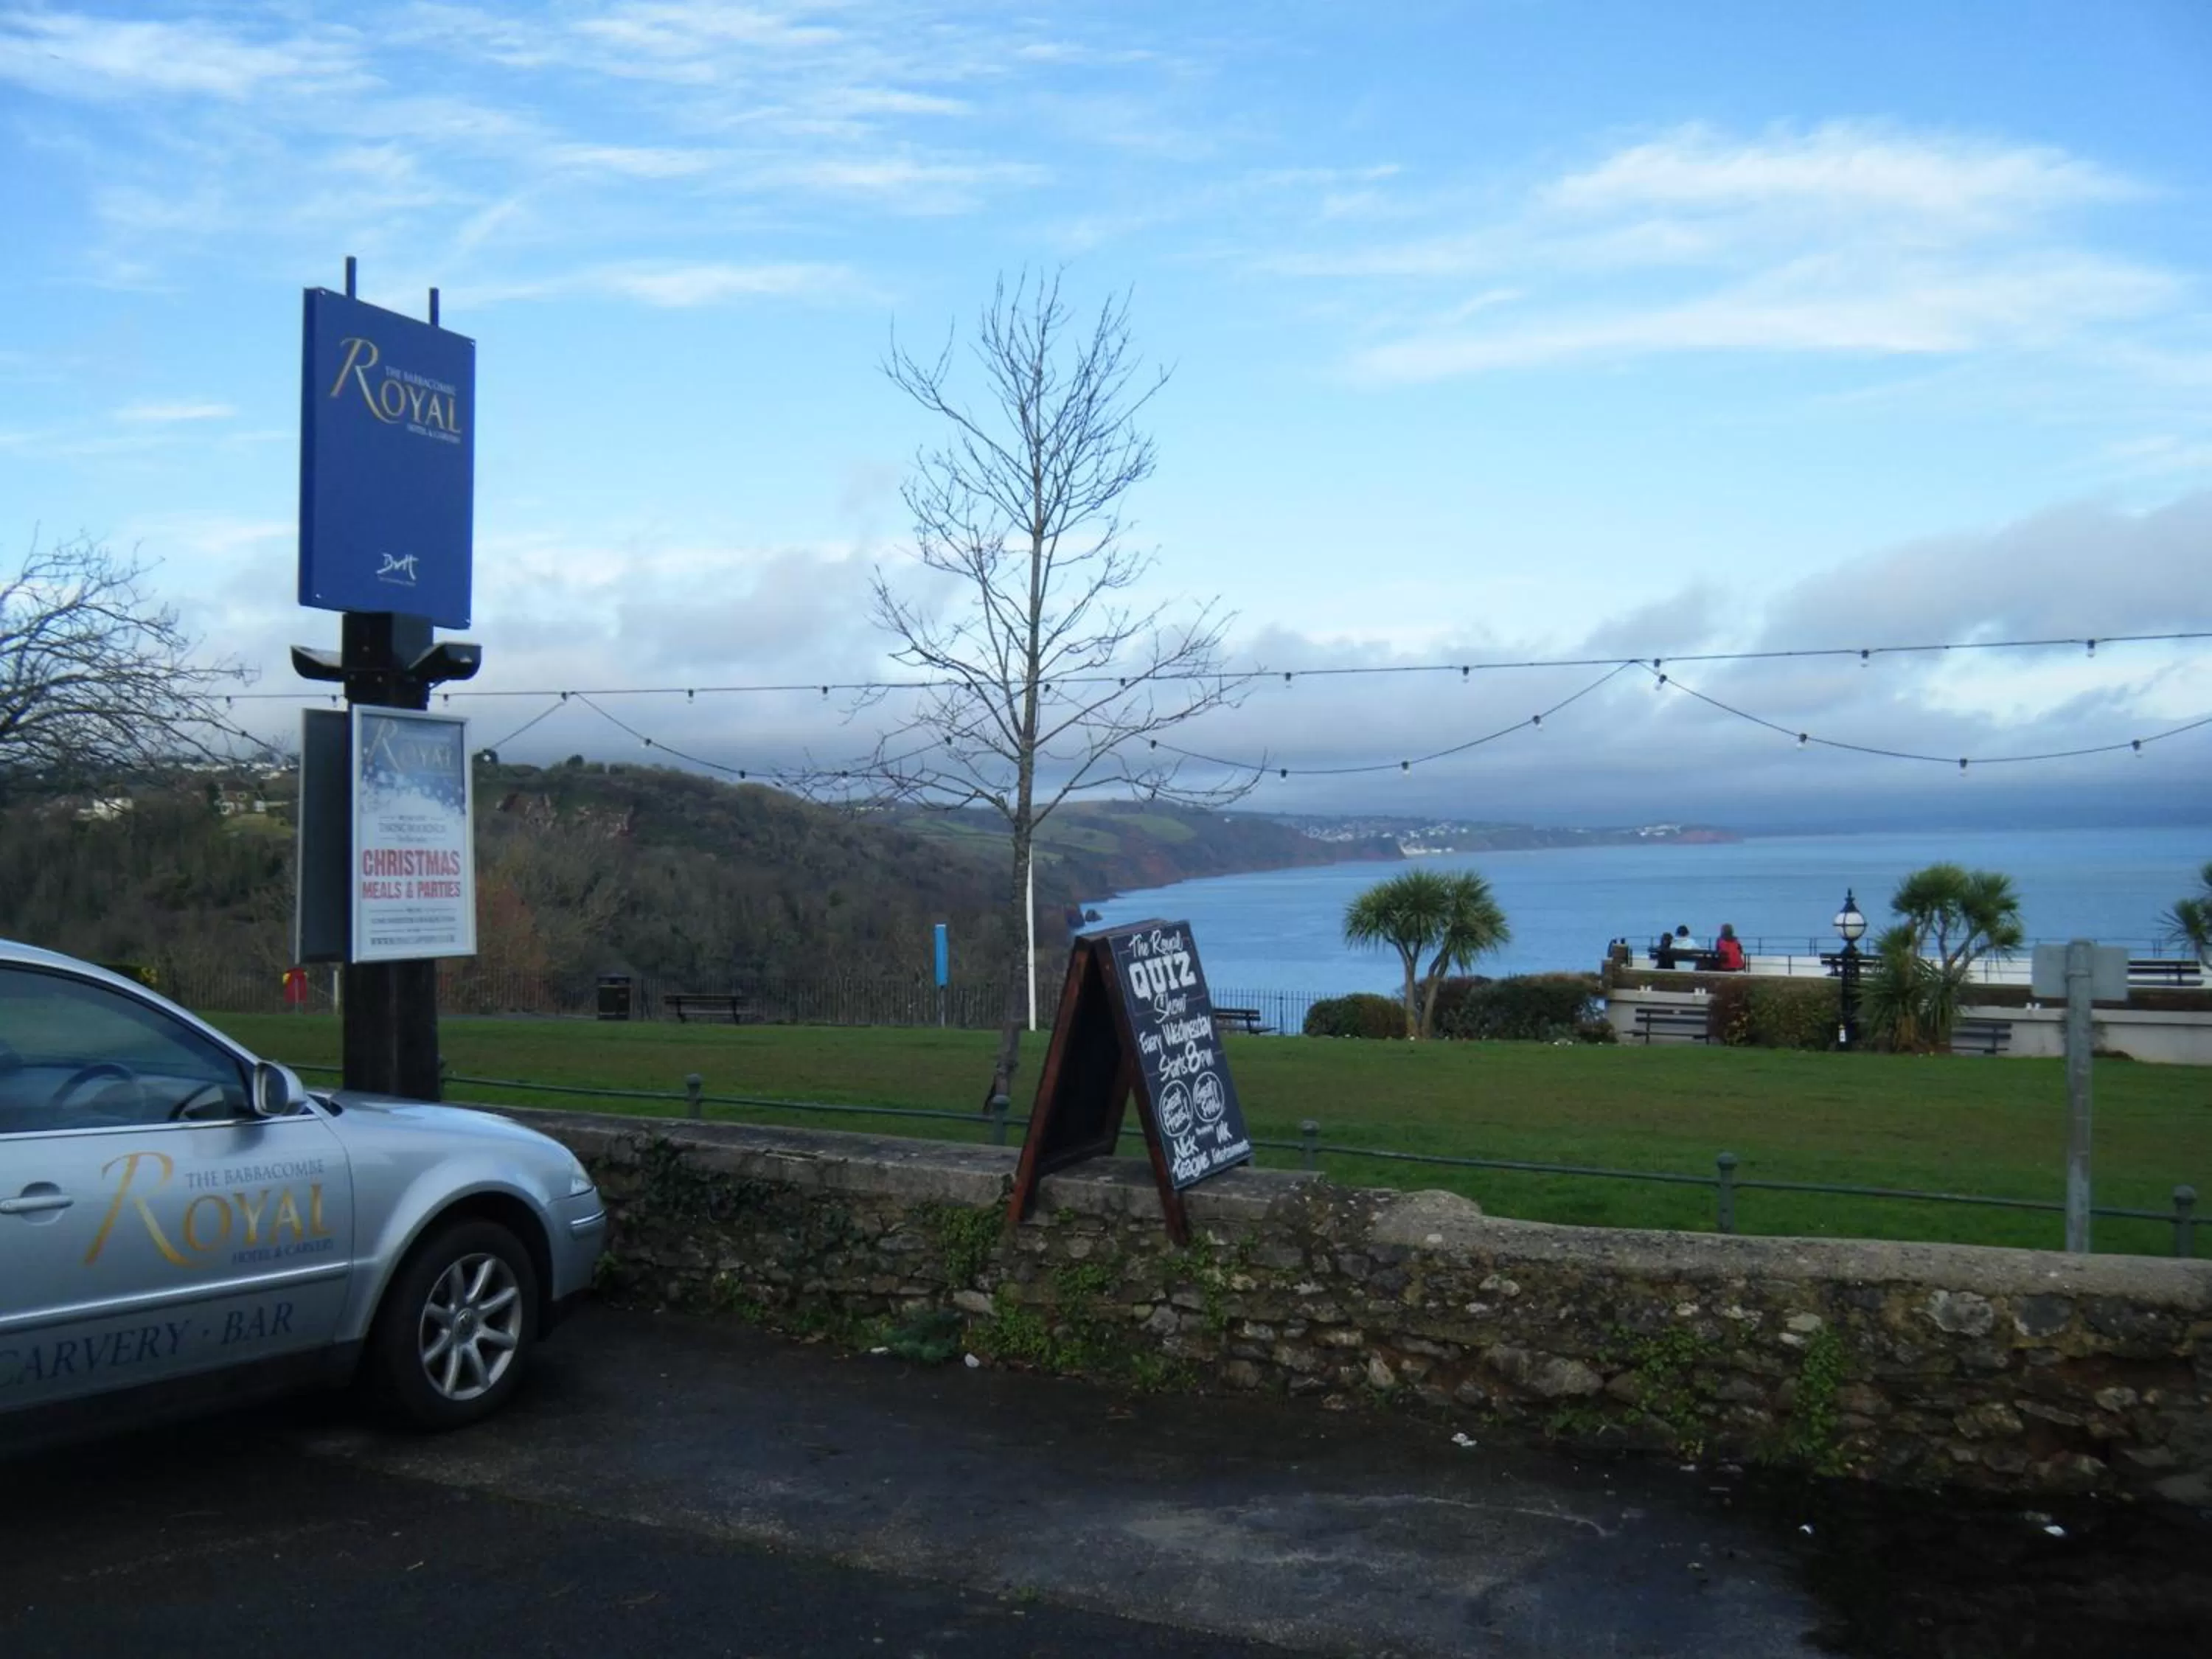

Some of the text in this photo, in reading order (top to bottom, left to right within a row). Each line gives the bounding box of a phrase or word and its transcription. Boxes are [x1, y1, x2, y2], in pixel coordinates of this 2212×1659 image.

[330, 337, 462, 434] ROYAL
[362, 849, 460, 876] CHRISTMAS
[361, 881, 461, 900] MEALS & PARTIES
[1128, 951, 1197, 1001] QUIZ
[185, 1170, 219, 1192] THE
[83, 1150, 335, 1270] ROYAL
[220, 1301, 296, 1346] BAR
